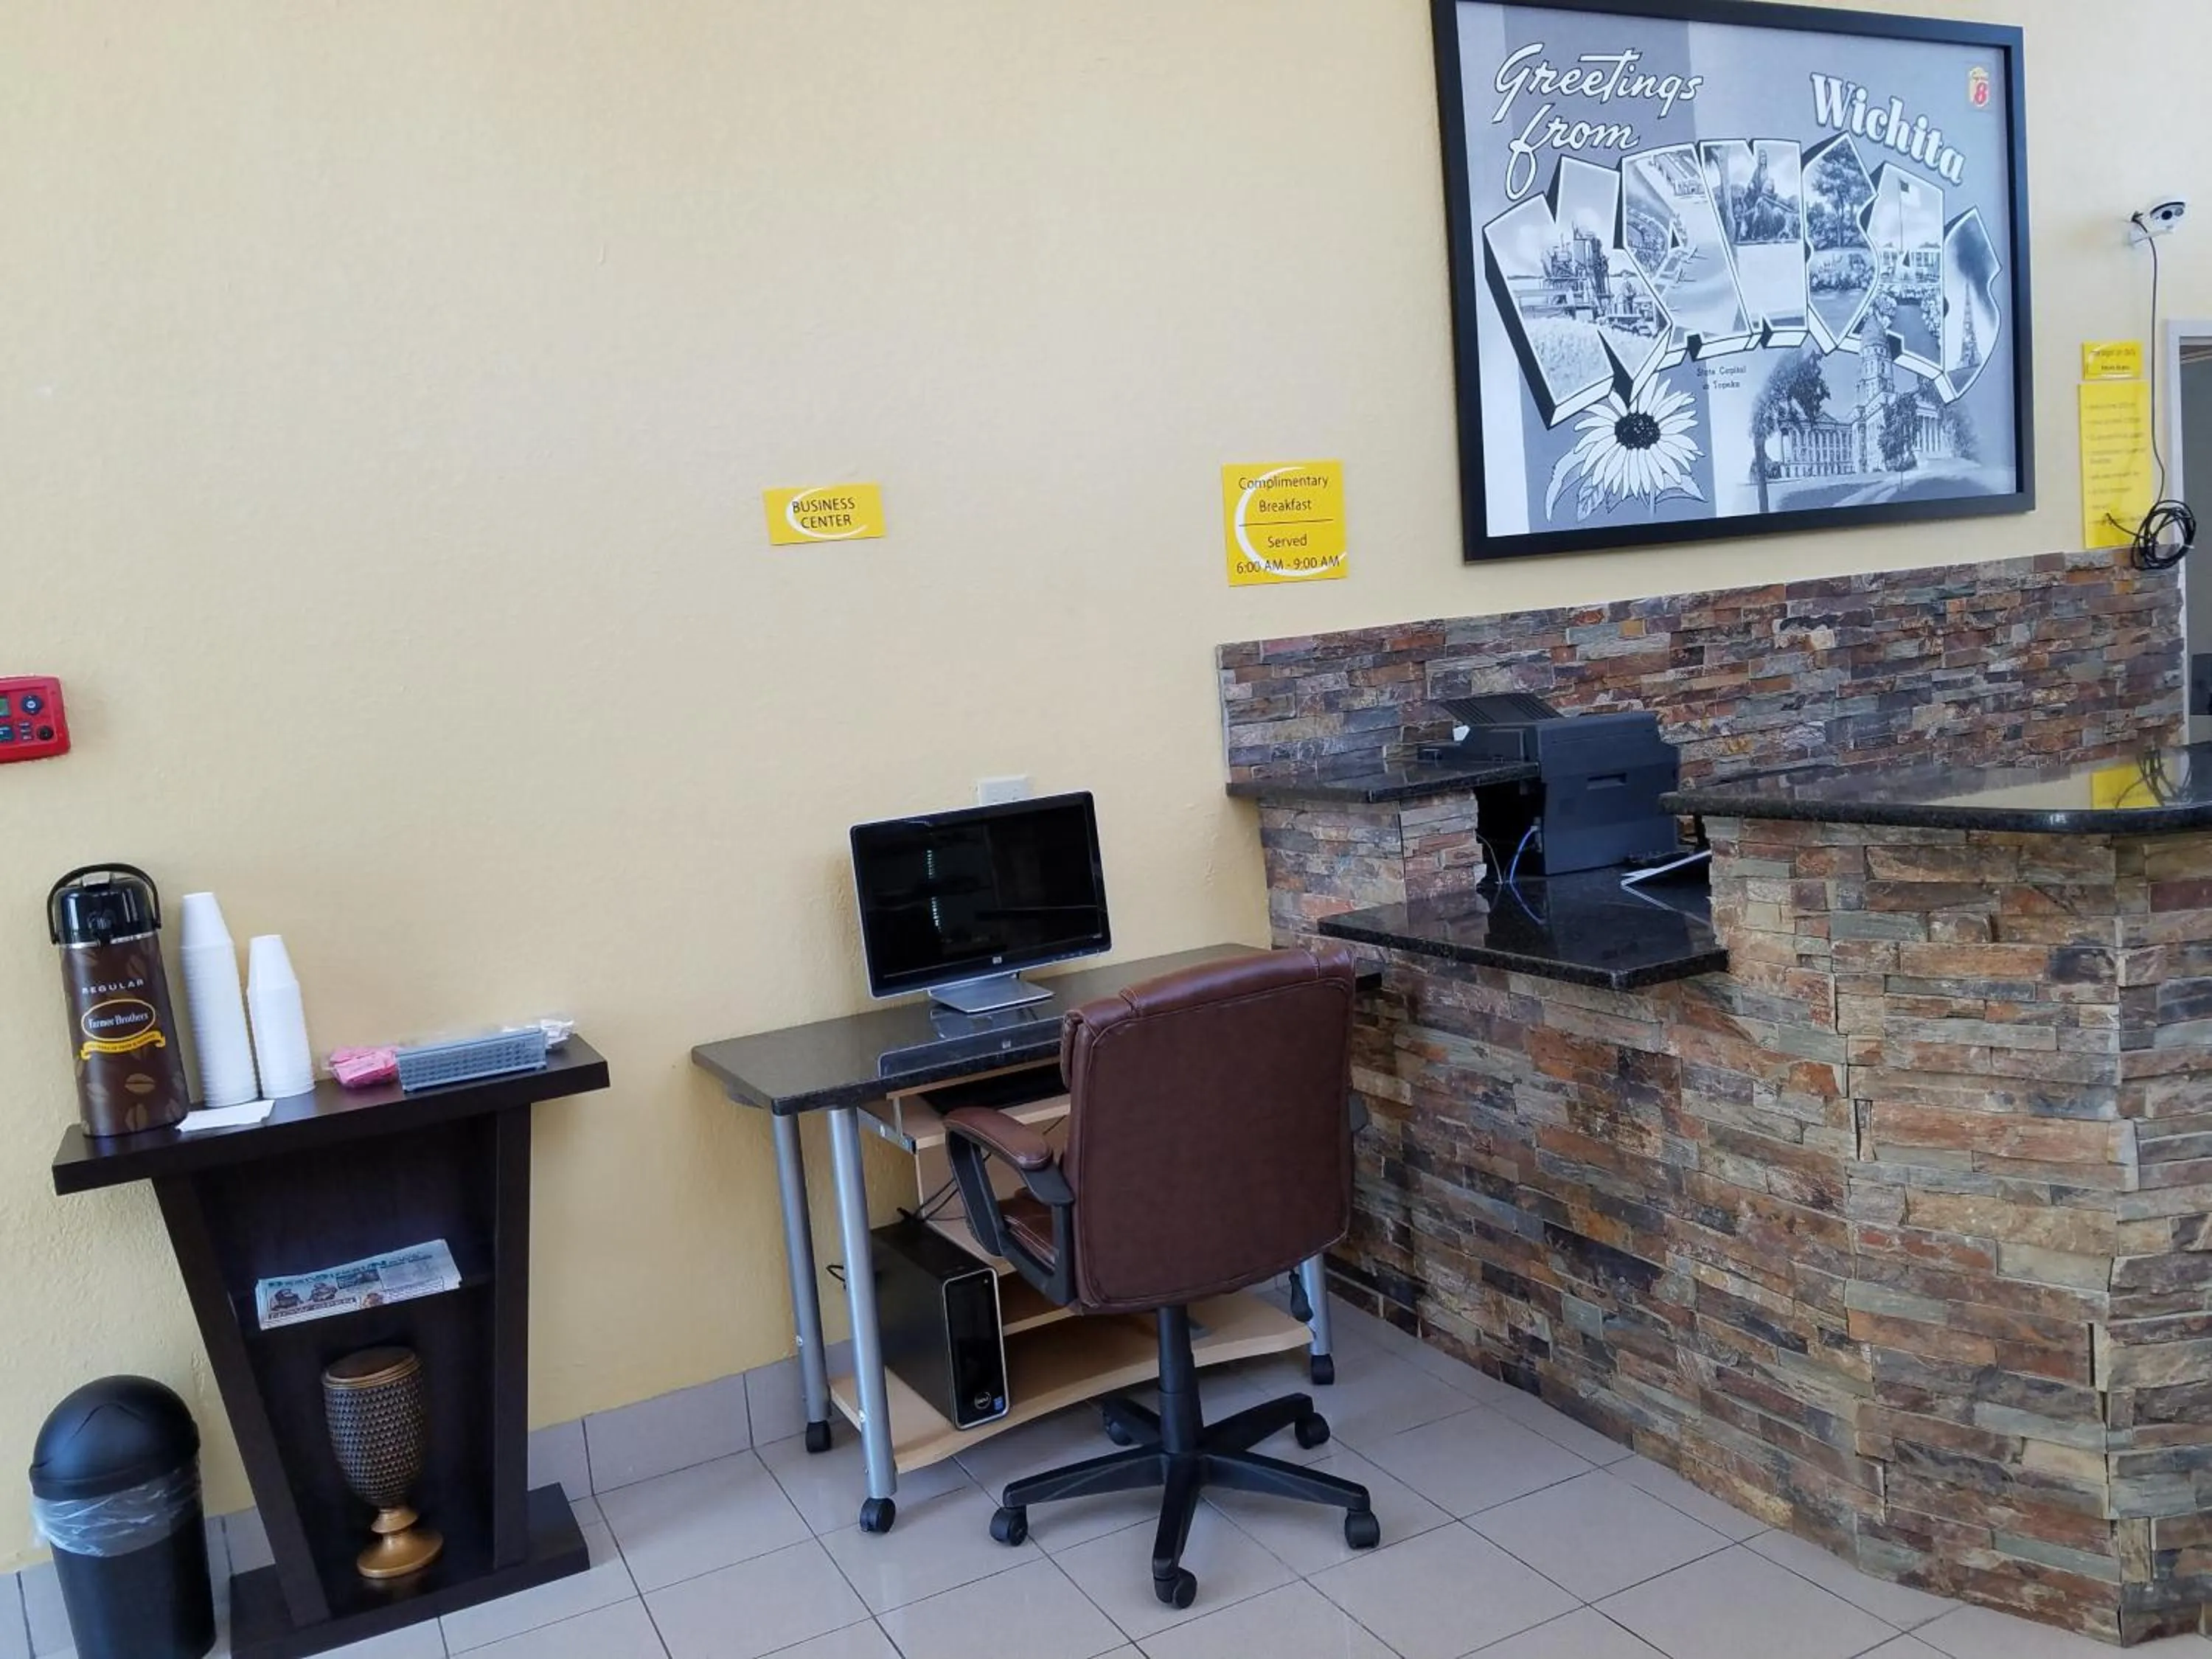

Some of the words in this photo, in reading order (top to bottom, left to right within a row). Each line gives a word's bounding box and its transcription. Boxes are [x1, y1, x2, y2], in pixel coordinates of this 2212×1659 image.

[1492, 42, 1704, 124] Greetings
[1809, 72, 1967, 187] Wichita
[1506, 102, 1641, 201] from
[1482, 136, 2003, 426] KANSAS
[1238, 476, 1329, 492] Complimentary
[792, 497, 855, 513] BUSINESS
[1259, 498, 1312, 512] Breakfast
[801, 514, 852, 529] CENTER
[1267, 533, 1307, 549] Served
[1237, 561, 1262, 574] 6:00
[1265, 559, 1284, 571] AM
[1294, 557, 1318, 569] 9:00
[1321, 555, 1340, 567] AM
[82, 978, 145, 995] REGULAR
